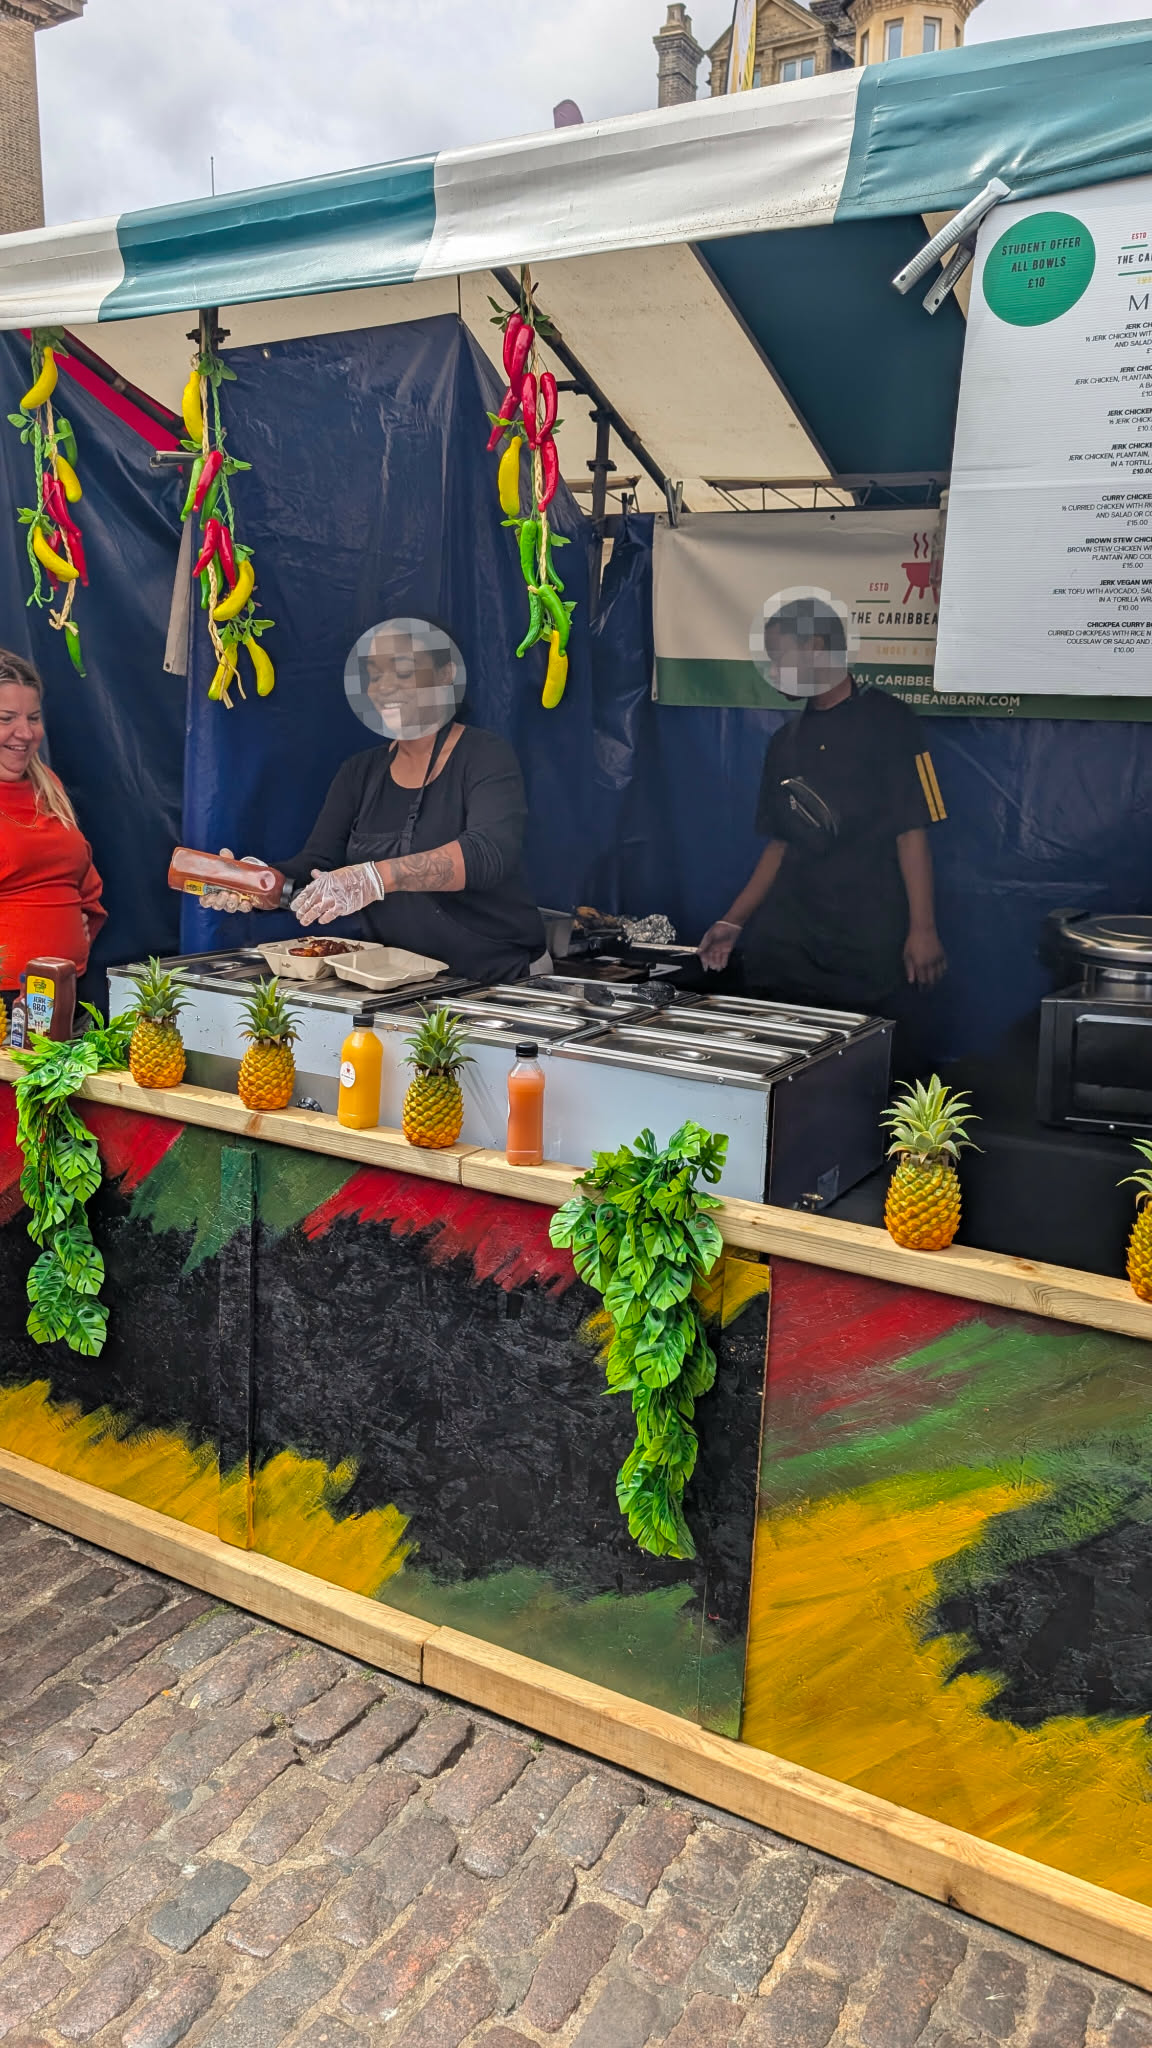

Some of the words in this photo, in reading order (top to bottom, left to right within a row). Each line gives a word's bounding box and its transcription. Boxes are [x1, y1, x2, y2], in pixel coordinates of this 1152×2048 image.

[1131, 232, 1147, 240] ESTD
[1002, 241, 1046, 256] STUDENT
[1050, 237, 1081, 250] OFFER
[1011, 261, 1028, 272] ALL
[1032, 256, 1066, 270] BOWLS
[1117, 254, 1134, 264] THE
[1138, 253, 1152, 263] CA
[1028, 277, 1045, 288] £10
[1129, 293, 1149, 311] M
[1092, 334, 1107, 342] JERK
[1108, 332, 1137, 340] CHICKEN
[1090, 375, 1120, 384] CHICKEN,
[1116, 451, 1149, 459] PLANTAIN,
[869, 583, 889, 592] ESTD
[851, 612, 872, 624] THE
[878, 612, 938, 625] CARIBBEA
[875, 674, 932, 686] CARIBBE
[33, 1003, 46, 1013] BBQ
